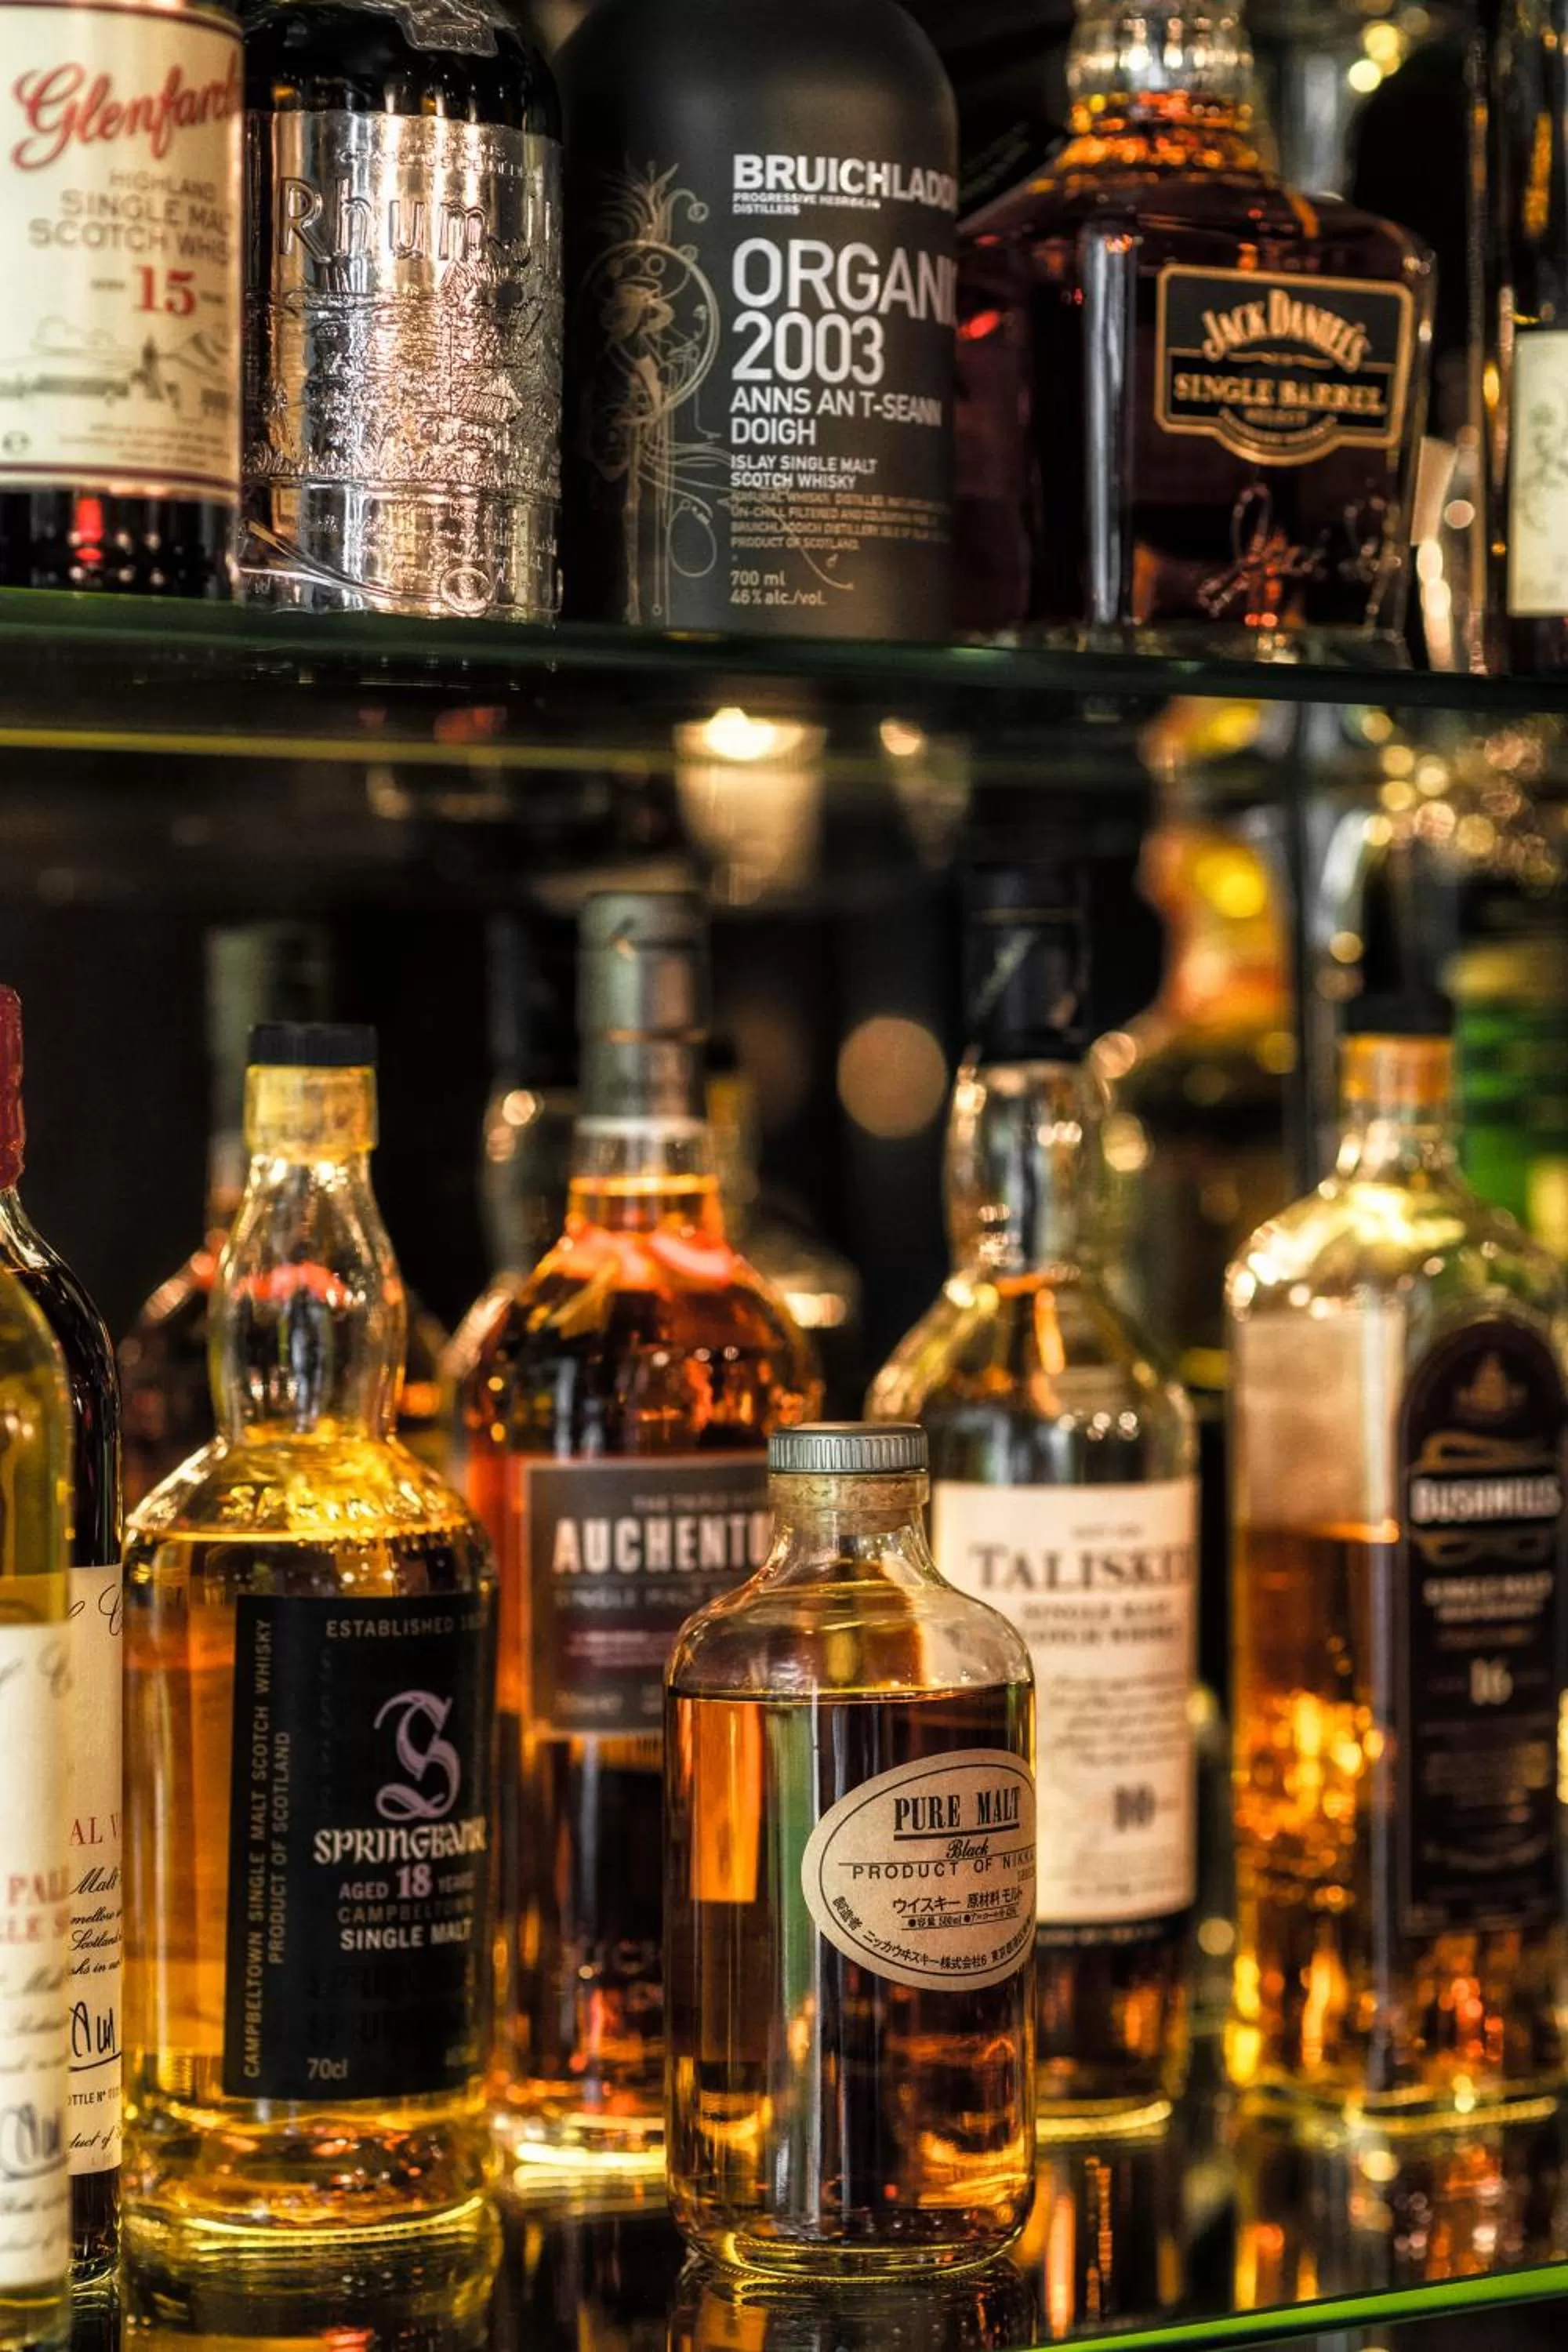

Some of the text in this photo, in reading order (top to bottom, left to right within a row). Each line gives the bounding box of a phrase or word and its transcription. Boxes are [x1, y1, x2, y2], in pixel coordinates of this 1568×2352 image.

[733, 154, 957, 214] BRUICHLADD
[733, 192, 816, 205] PROGRESSIVE
[60, 189, 180, 226] SINGLE
[278, 176, 487, 263] Rhum
[732, 203, 800, 216] DISTILLERS
[28, 217, 168, 256] SCOTCH
[136, 264, 197, 318] 15
[731, 310, 884, 385] 2003
[1202, 301, 1267, 361] JACK
[730, 387, 811, 414] ANNS
[816, 388, 854, 416] AN
[1174, 372, 1387, 416] SINGLE BARREL
[731, 417, 816, 445] DOIGH
[731, 455, 877, 474] ISLAY SINGLE MALT
[731, 472, 856, 490] SCOTCH WHISKY
[730, 570, 786, 586] 700 ml
[325, 1617, 454, 1639] ESTABLISHED
[894, 1786, 1020, 1831] PURE MALT
[243, 1619, 271, 2078] CAMPBELTOWN SINGLE MALT SCOTCH WHISKY
[268, 1732, 291, 1964] PRODUCT OF SCOTLAND
[314, 1815, 487, 1864] SPRINGBANK
[946, 1837, 989, 1860] Black
[338, 1882, 389, 1900] AGED
[395, 1863, 431, 1899] 18
[852, 1864, 959, 1880] PRODUCT
[974, 1857, 992, 1873] OF
[893, 1896, 960, 1915] ウイスキー
[339, 1926, 424, 1951] SINGLE
[307, 2058, 347, 2078] 70cl
